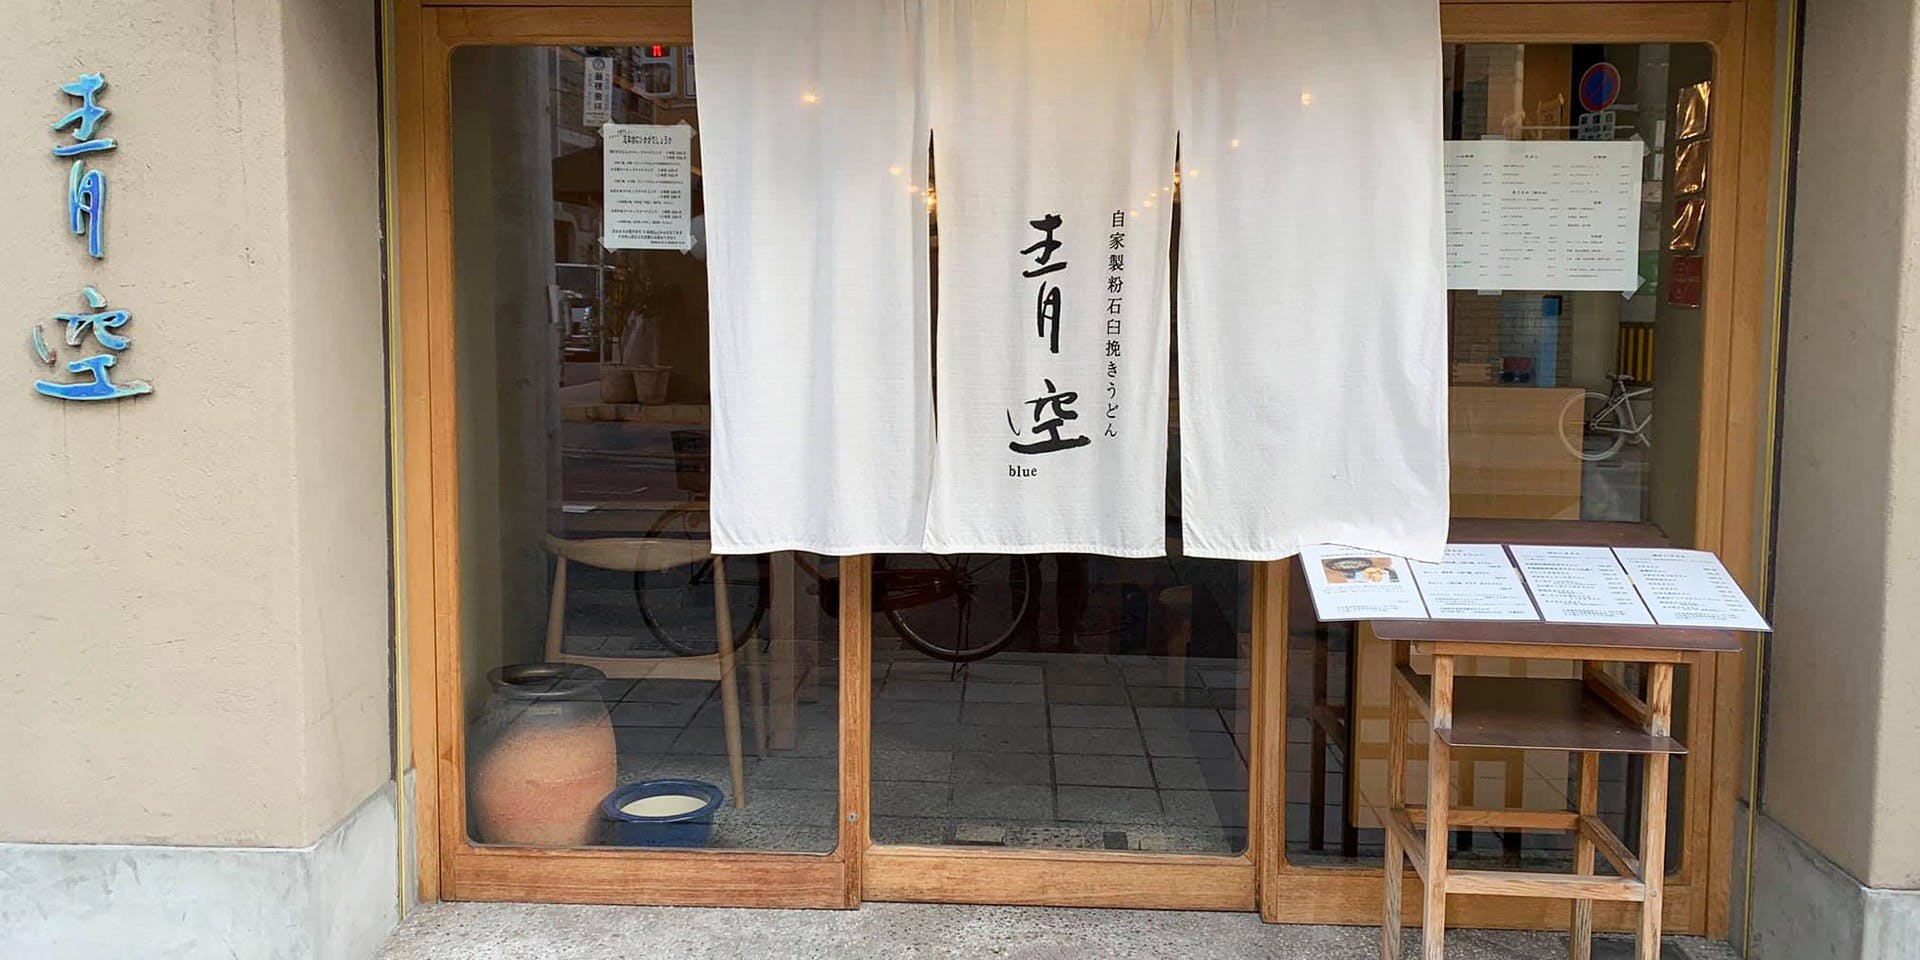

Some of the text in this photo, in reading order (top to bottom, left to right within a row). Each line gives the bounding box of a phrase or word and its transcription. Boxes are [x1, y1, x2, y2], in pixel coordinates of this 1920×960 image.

[1104, 209, 1126, 438] 自家製粉石臼挽きうどん
[1008, 464, 1038, 478] blue
